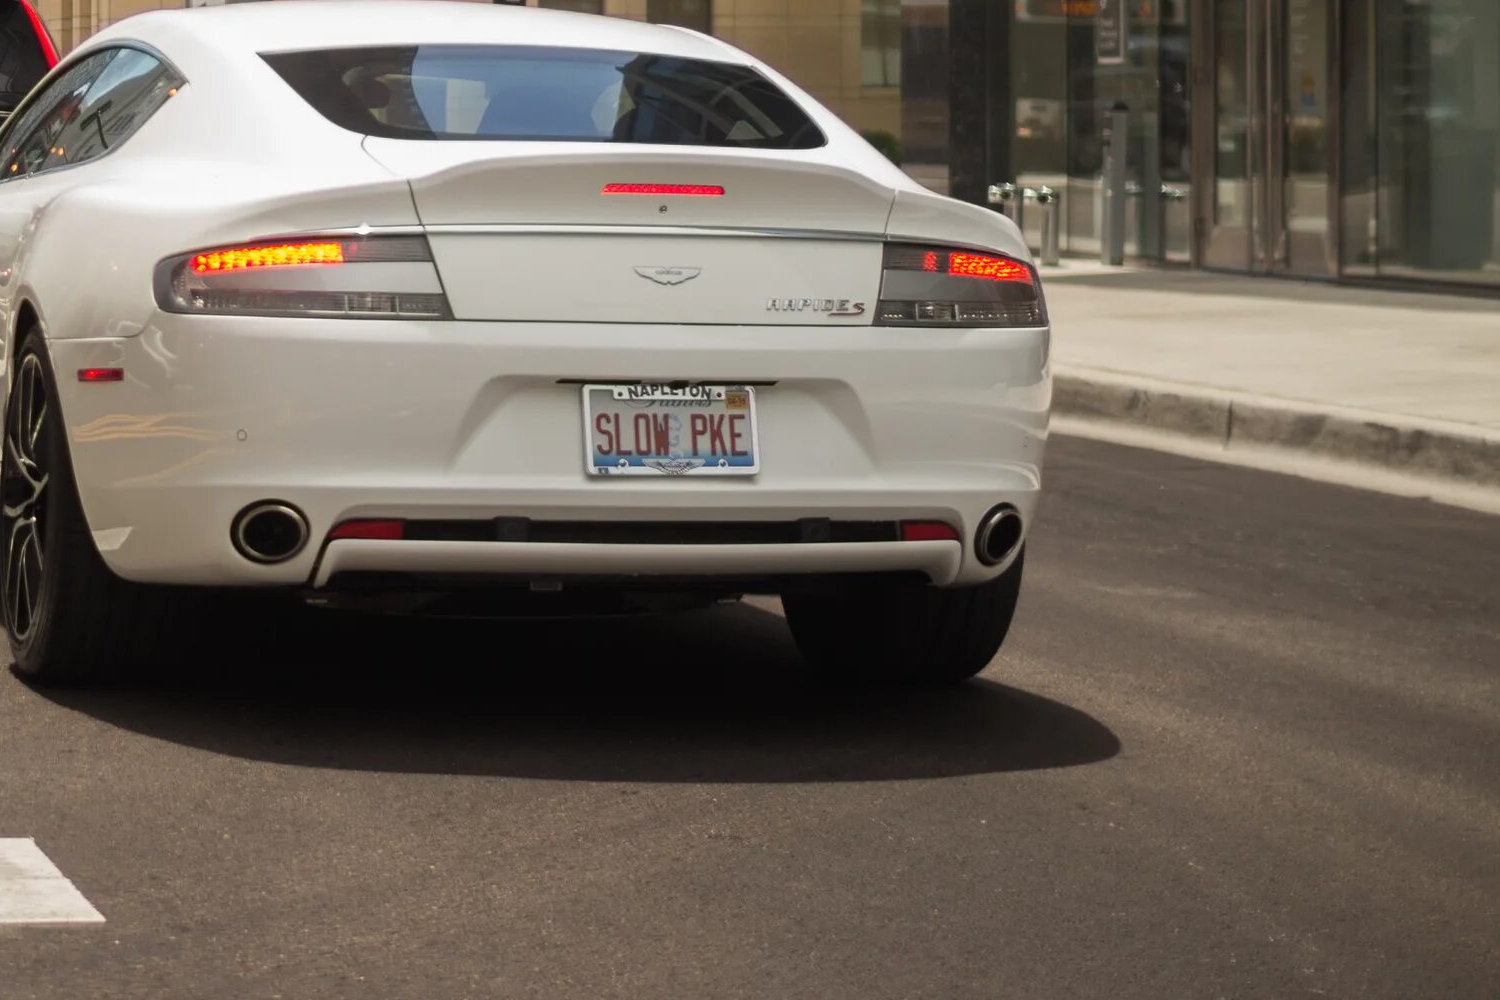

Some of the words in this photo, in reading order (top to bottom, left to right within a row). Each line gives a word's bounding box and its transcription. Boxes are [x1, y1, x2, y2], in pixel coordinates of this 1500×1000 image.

[766, 298, 850, 312] RAPIDE
[595, 412, 670, 457] SLOW
[690, 413, 749, 457] PKE
